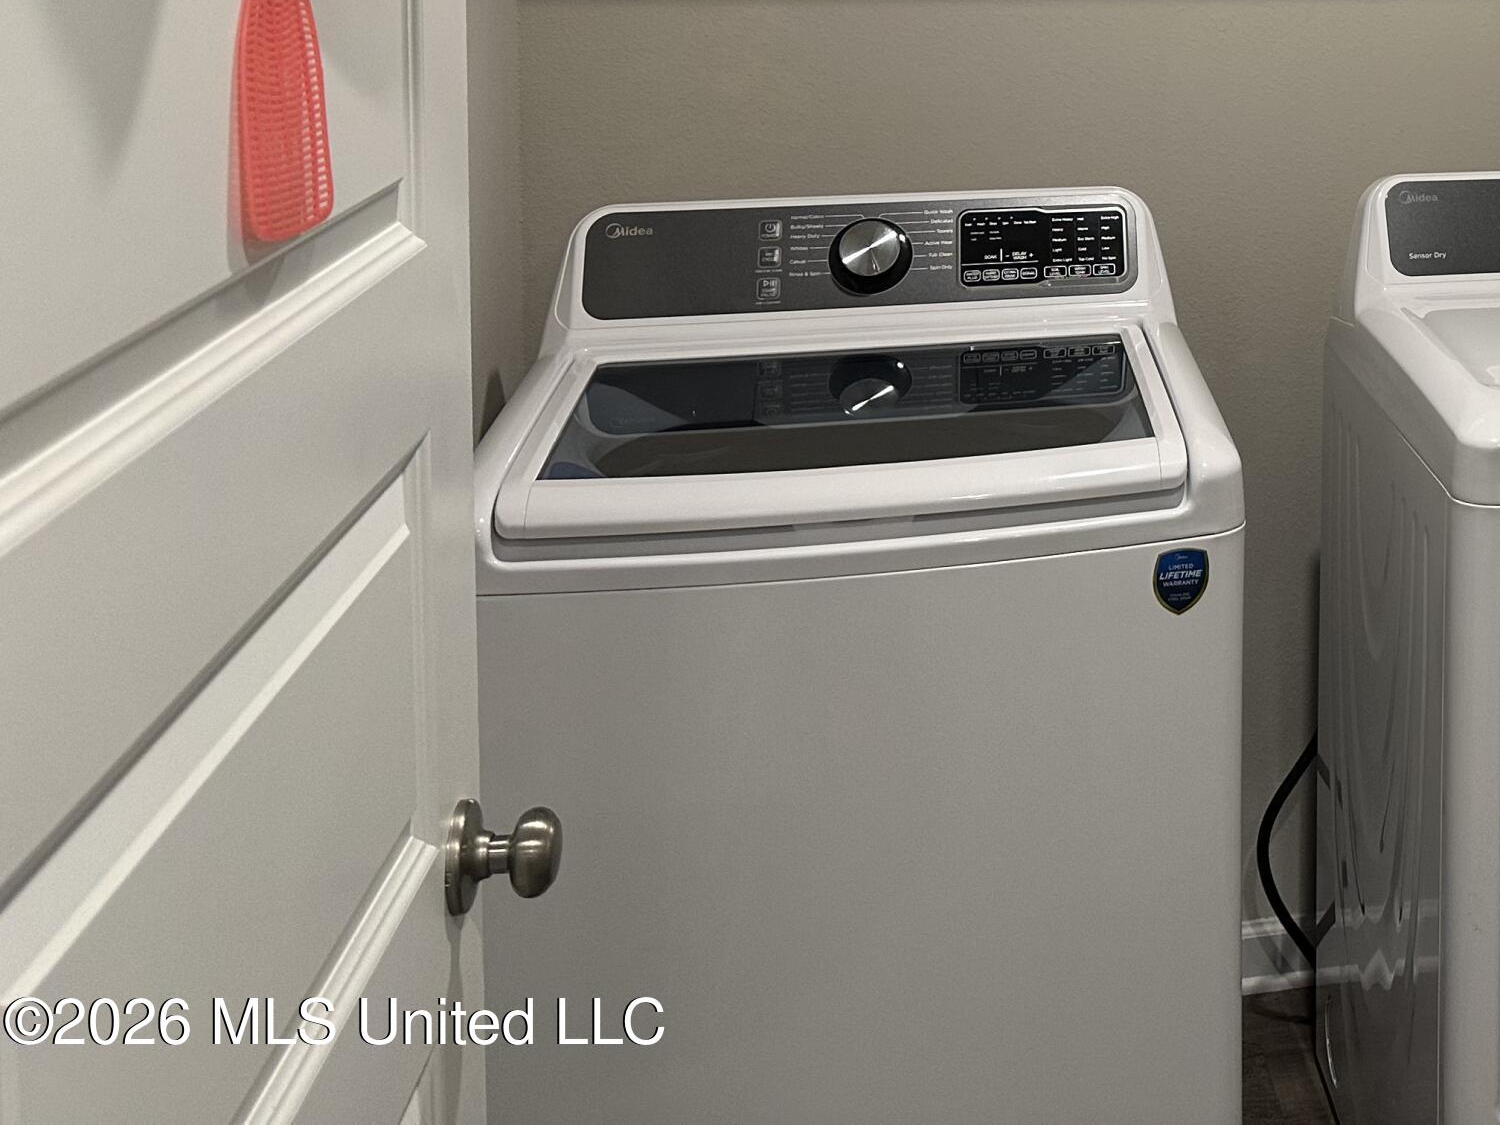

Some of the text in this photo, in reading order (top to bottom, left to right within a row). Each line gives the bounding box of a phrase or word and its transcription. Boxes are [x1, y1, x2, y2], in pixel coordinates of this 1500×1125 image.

[1400, 190, 1439, 204] Midea
[605, 222, 654, 238] Midea
[1433, 251, 1447, 259] Dry
[1159, 569, 1203, 580] LIFETIME
[1162, 579, 1199, 587] WARRANTY
